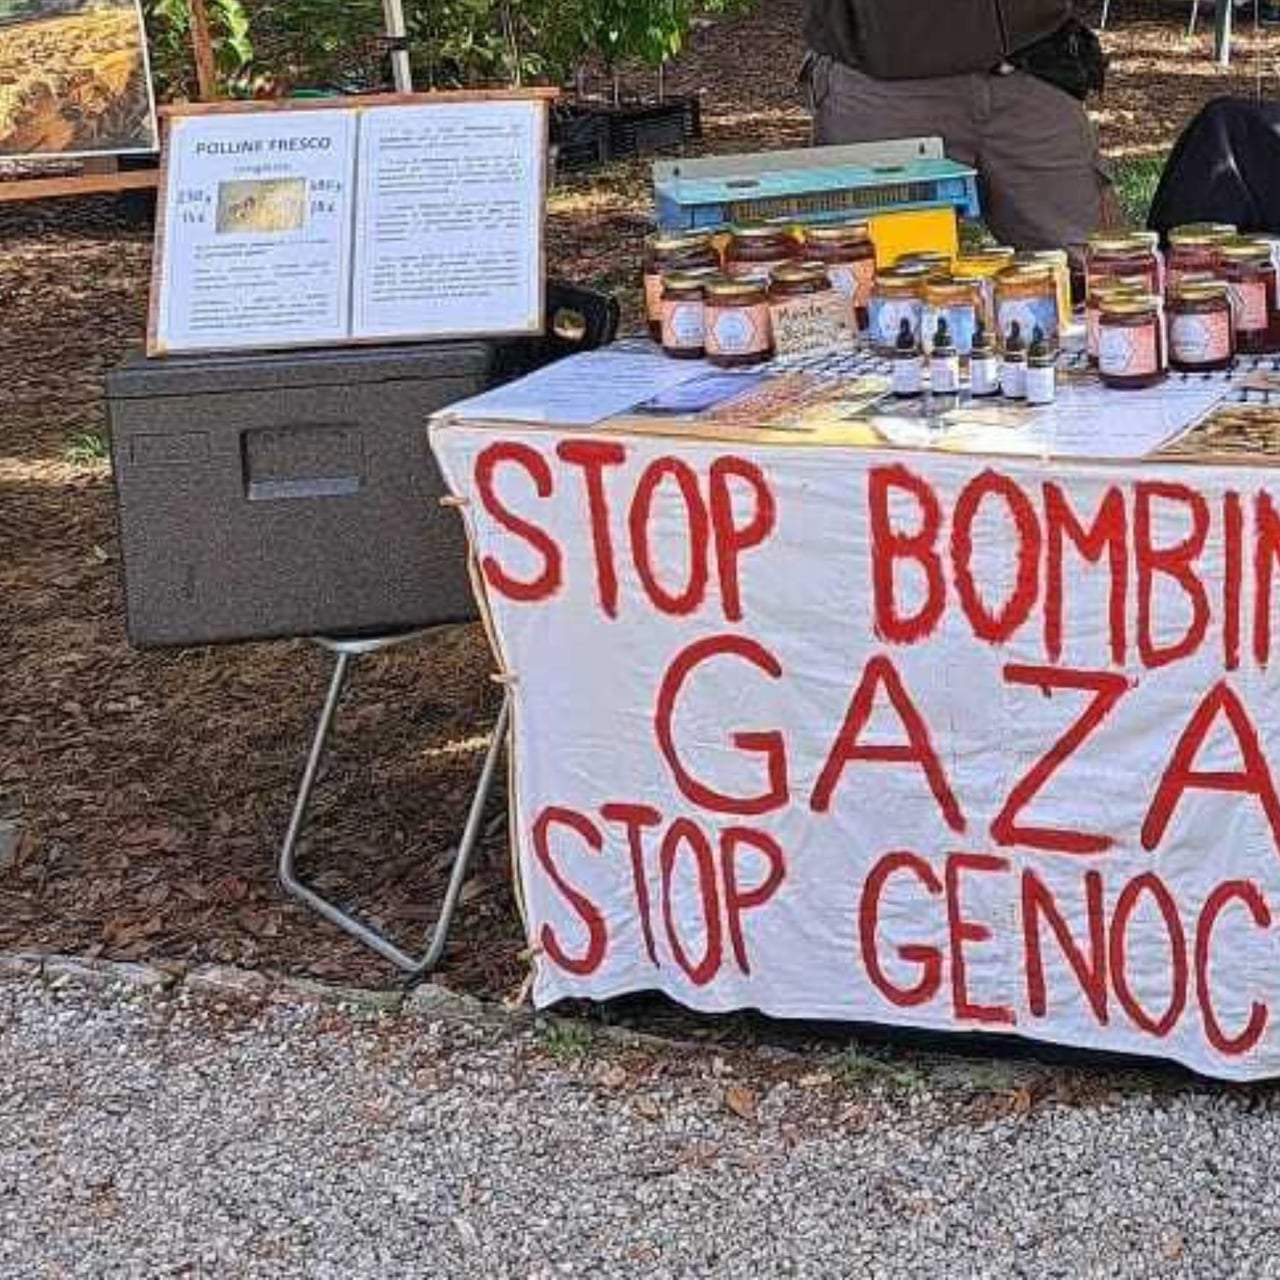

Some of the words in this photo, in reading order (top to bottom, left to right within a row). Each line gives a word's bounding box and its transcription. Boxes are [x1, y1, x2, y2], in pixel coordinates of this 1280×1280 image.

[196, 140, 264, 155] POLLINE
[268, 136, 332, 152] FRESCO
[474, 438, 776, 624] STOP
[532, 805, 786, 984] STOP
